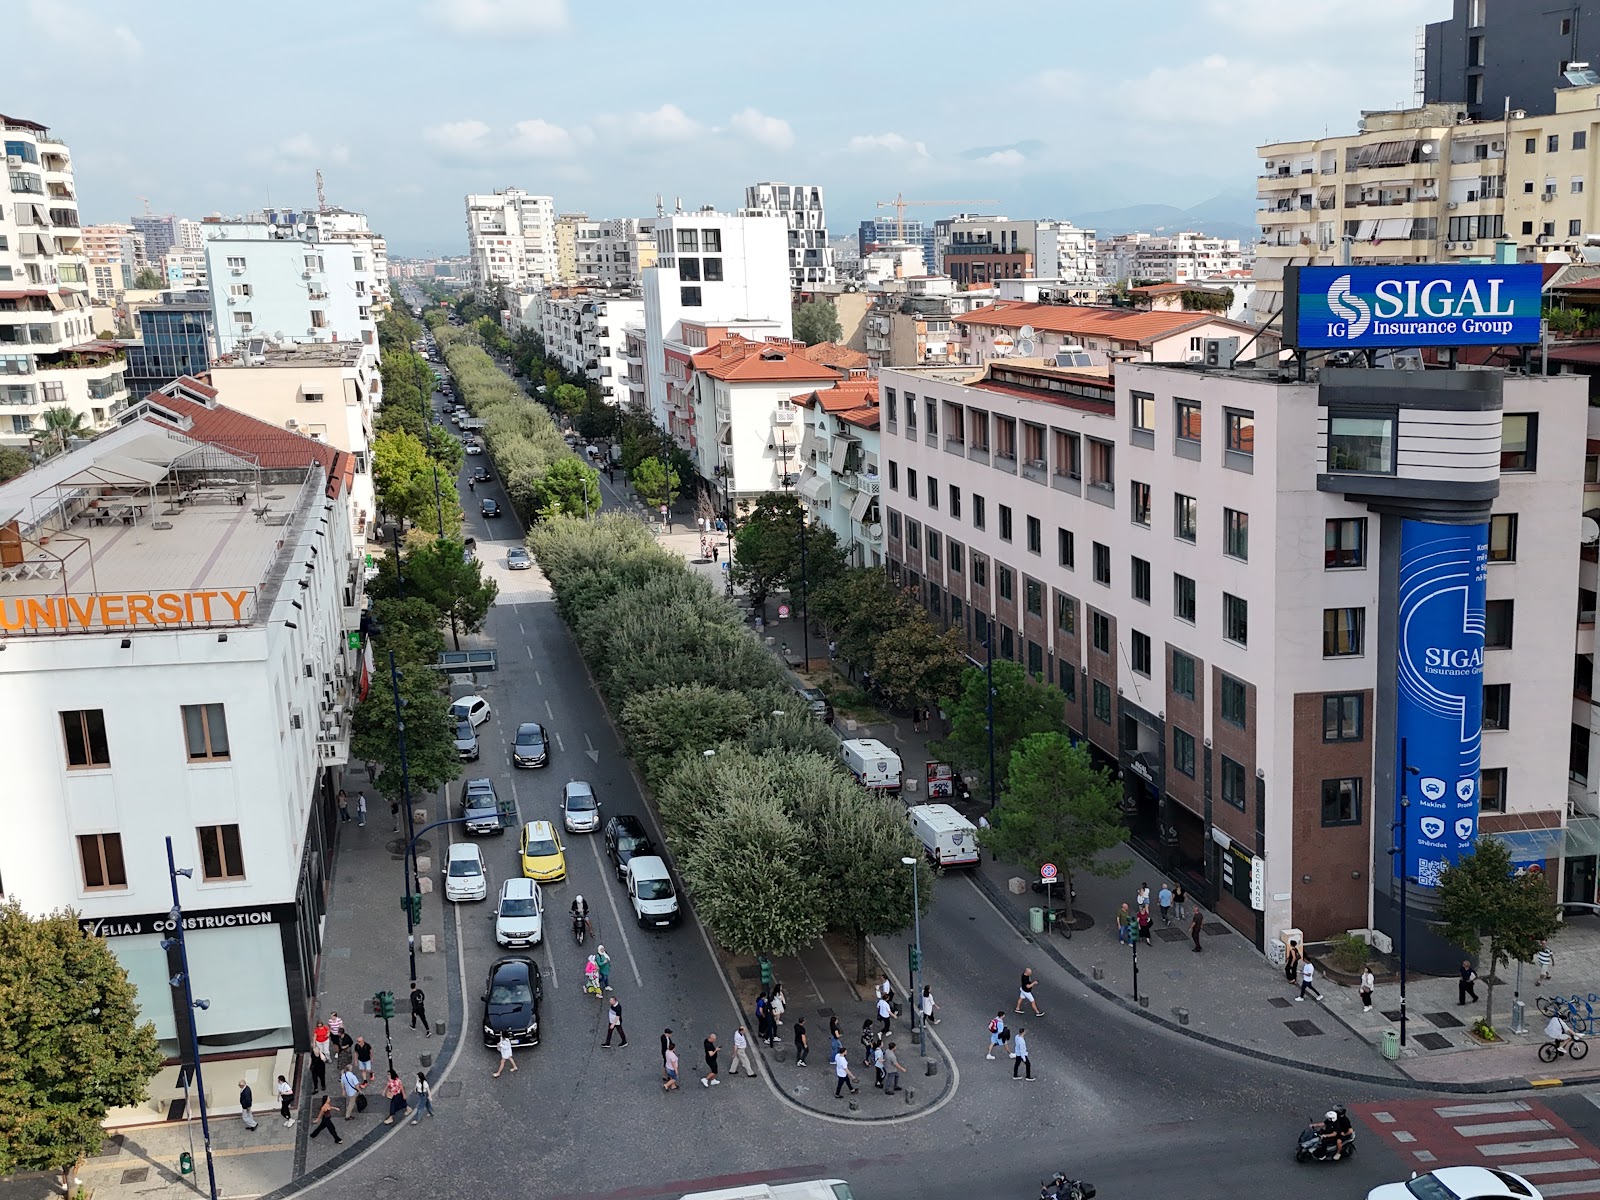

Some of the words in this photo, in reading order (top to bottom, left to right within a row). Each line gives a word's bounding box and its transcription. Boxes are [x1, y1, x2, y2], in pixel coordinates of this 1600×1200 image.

[1374, 279, 1514, 318] SIGAL
[1327, 322, 1345, 337] IG
[1373, 320, 1457, 335] Insurance
[1462, 318, 1513, 335] Group
[0, 590, 248, 630] UNIVERSITY
[1425, 666, 1470, 676] Insurance
[1420, 800, 1447, 809] Makinë
[153, 911, 272, 932] CONSTRUCTION
